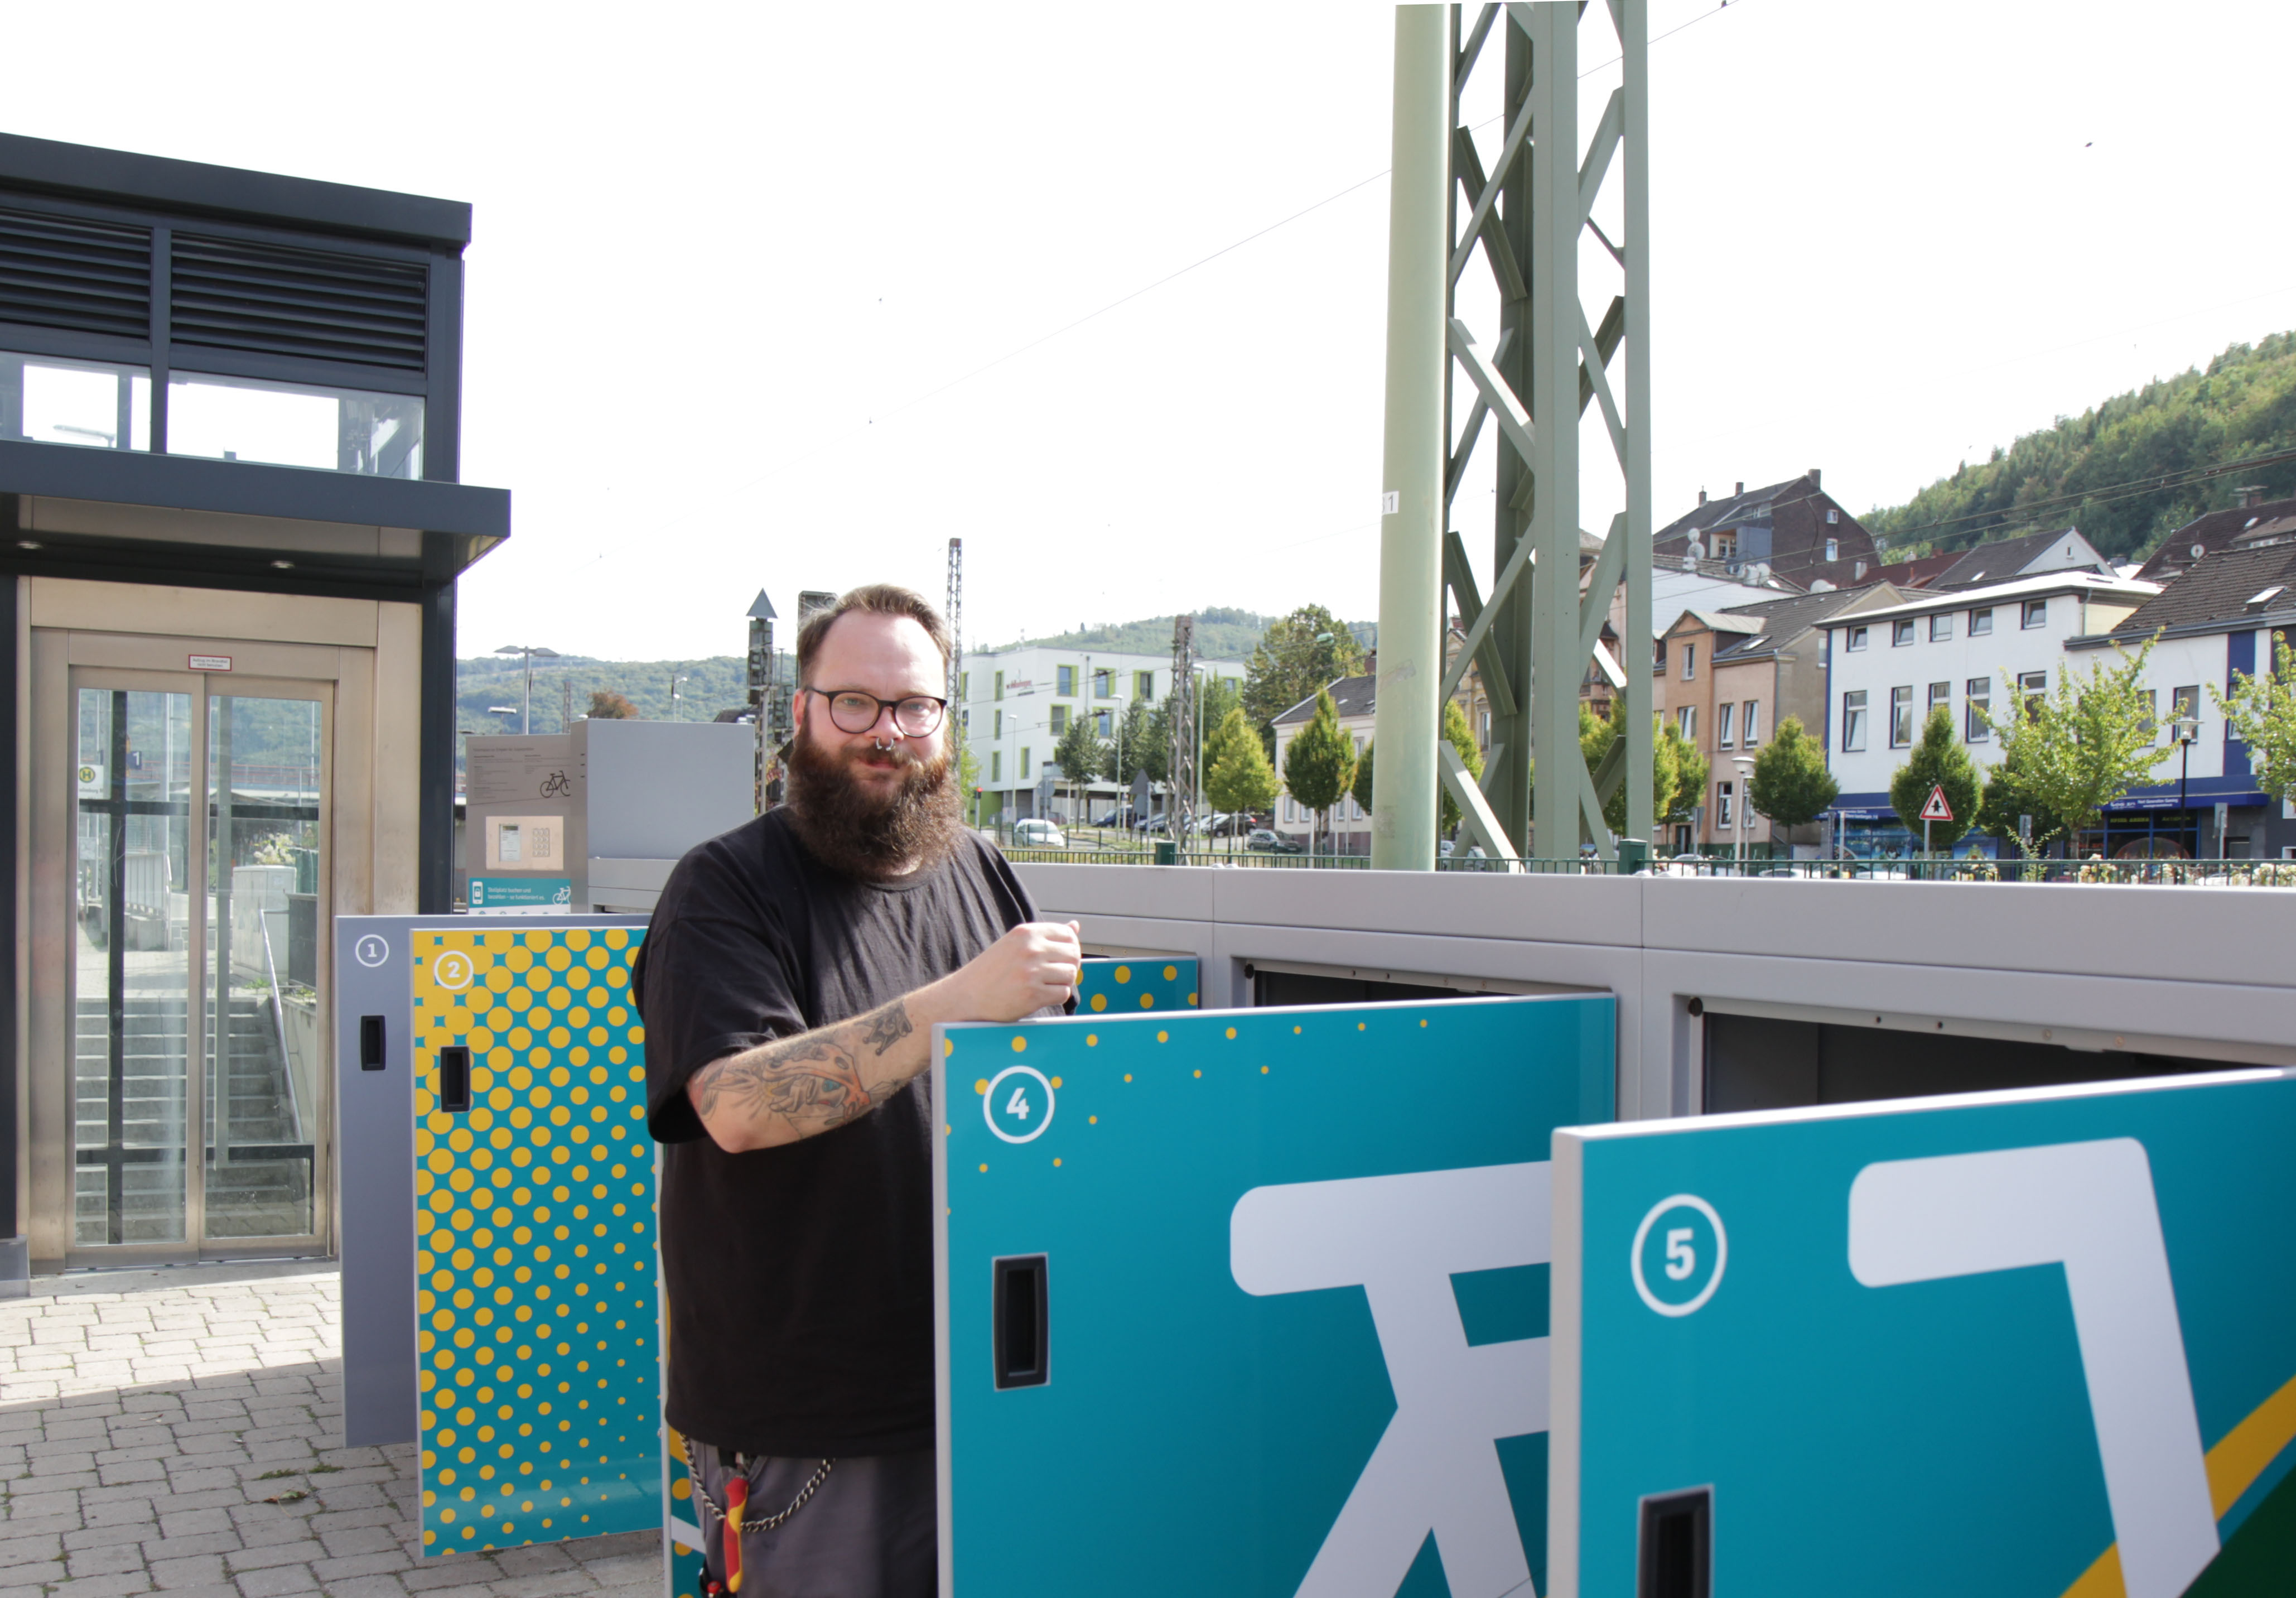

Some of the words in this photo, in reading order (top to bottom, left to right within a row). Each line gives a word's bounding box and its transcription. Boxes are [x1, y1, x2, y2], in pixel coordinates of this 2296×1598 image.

[132, 751, 140, 766] 1
[83, 769, 91, 779] H
[368, 943, 378, 957] 1
[447, 961, 460, 978] 2
[1006, 1087, 1030, 1120] 4
[1665, 1227, 1696, 1281] 5
